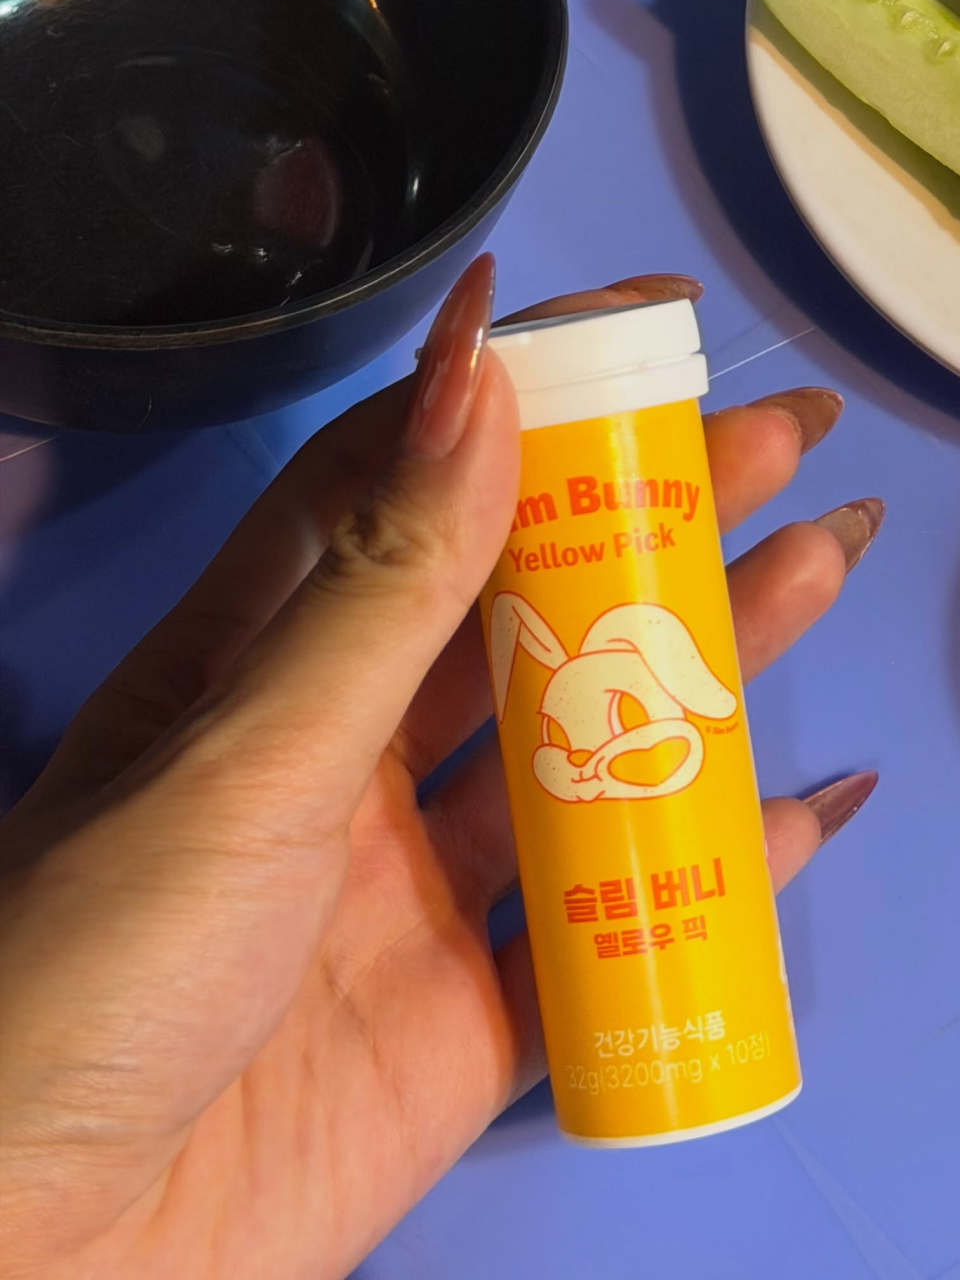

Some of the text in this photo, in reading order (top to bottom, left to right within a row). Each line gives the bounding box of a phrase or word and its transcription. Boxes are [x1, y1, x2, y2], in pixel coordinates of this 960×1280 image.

[567, 475, 700, 522] Bunny
[508, 522, 676, 573] Yellow Pick
[564, 857, 726, 924] 슬림 버니
[594, 915, 707, 959] 옐로우 픽
[594, 1010, 726, 1059] 건강기능식품
[565, 1058, 703, 1096] 32g(3200mg
[726, 1030, 771, 1066] 10정)
